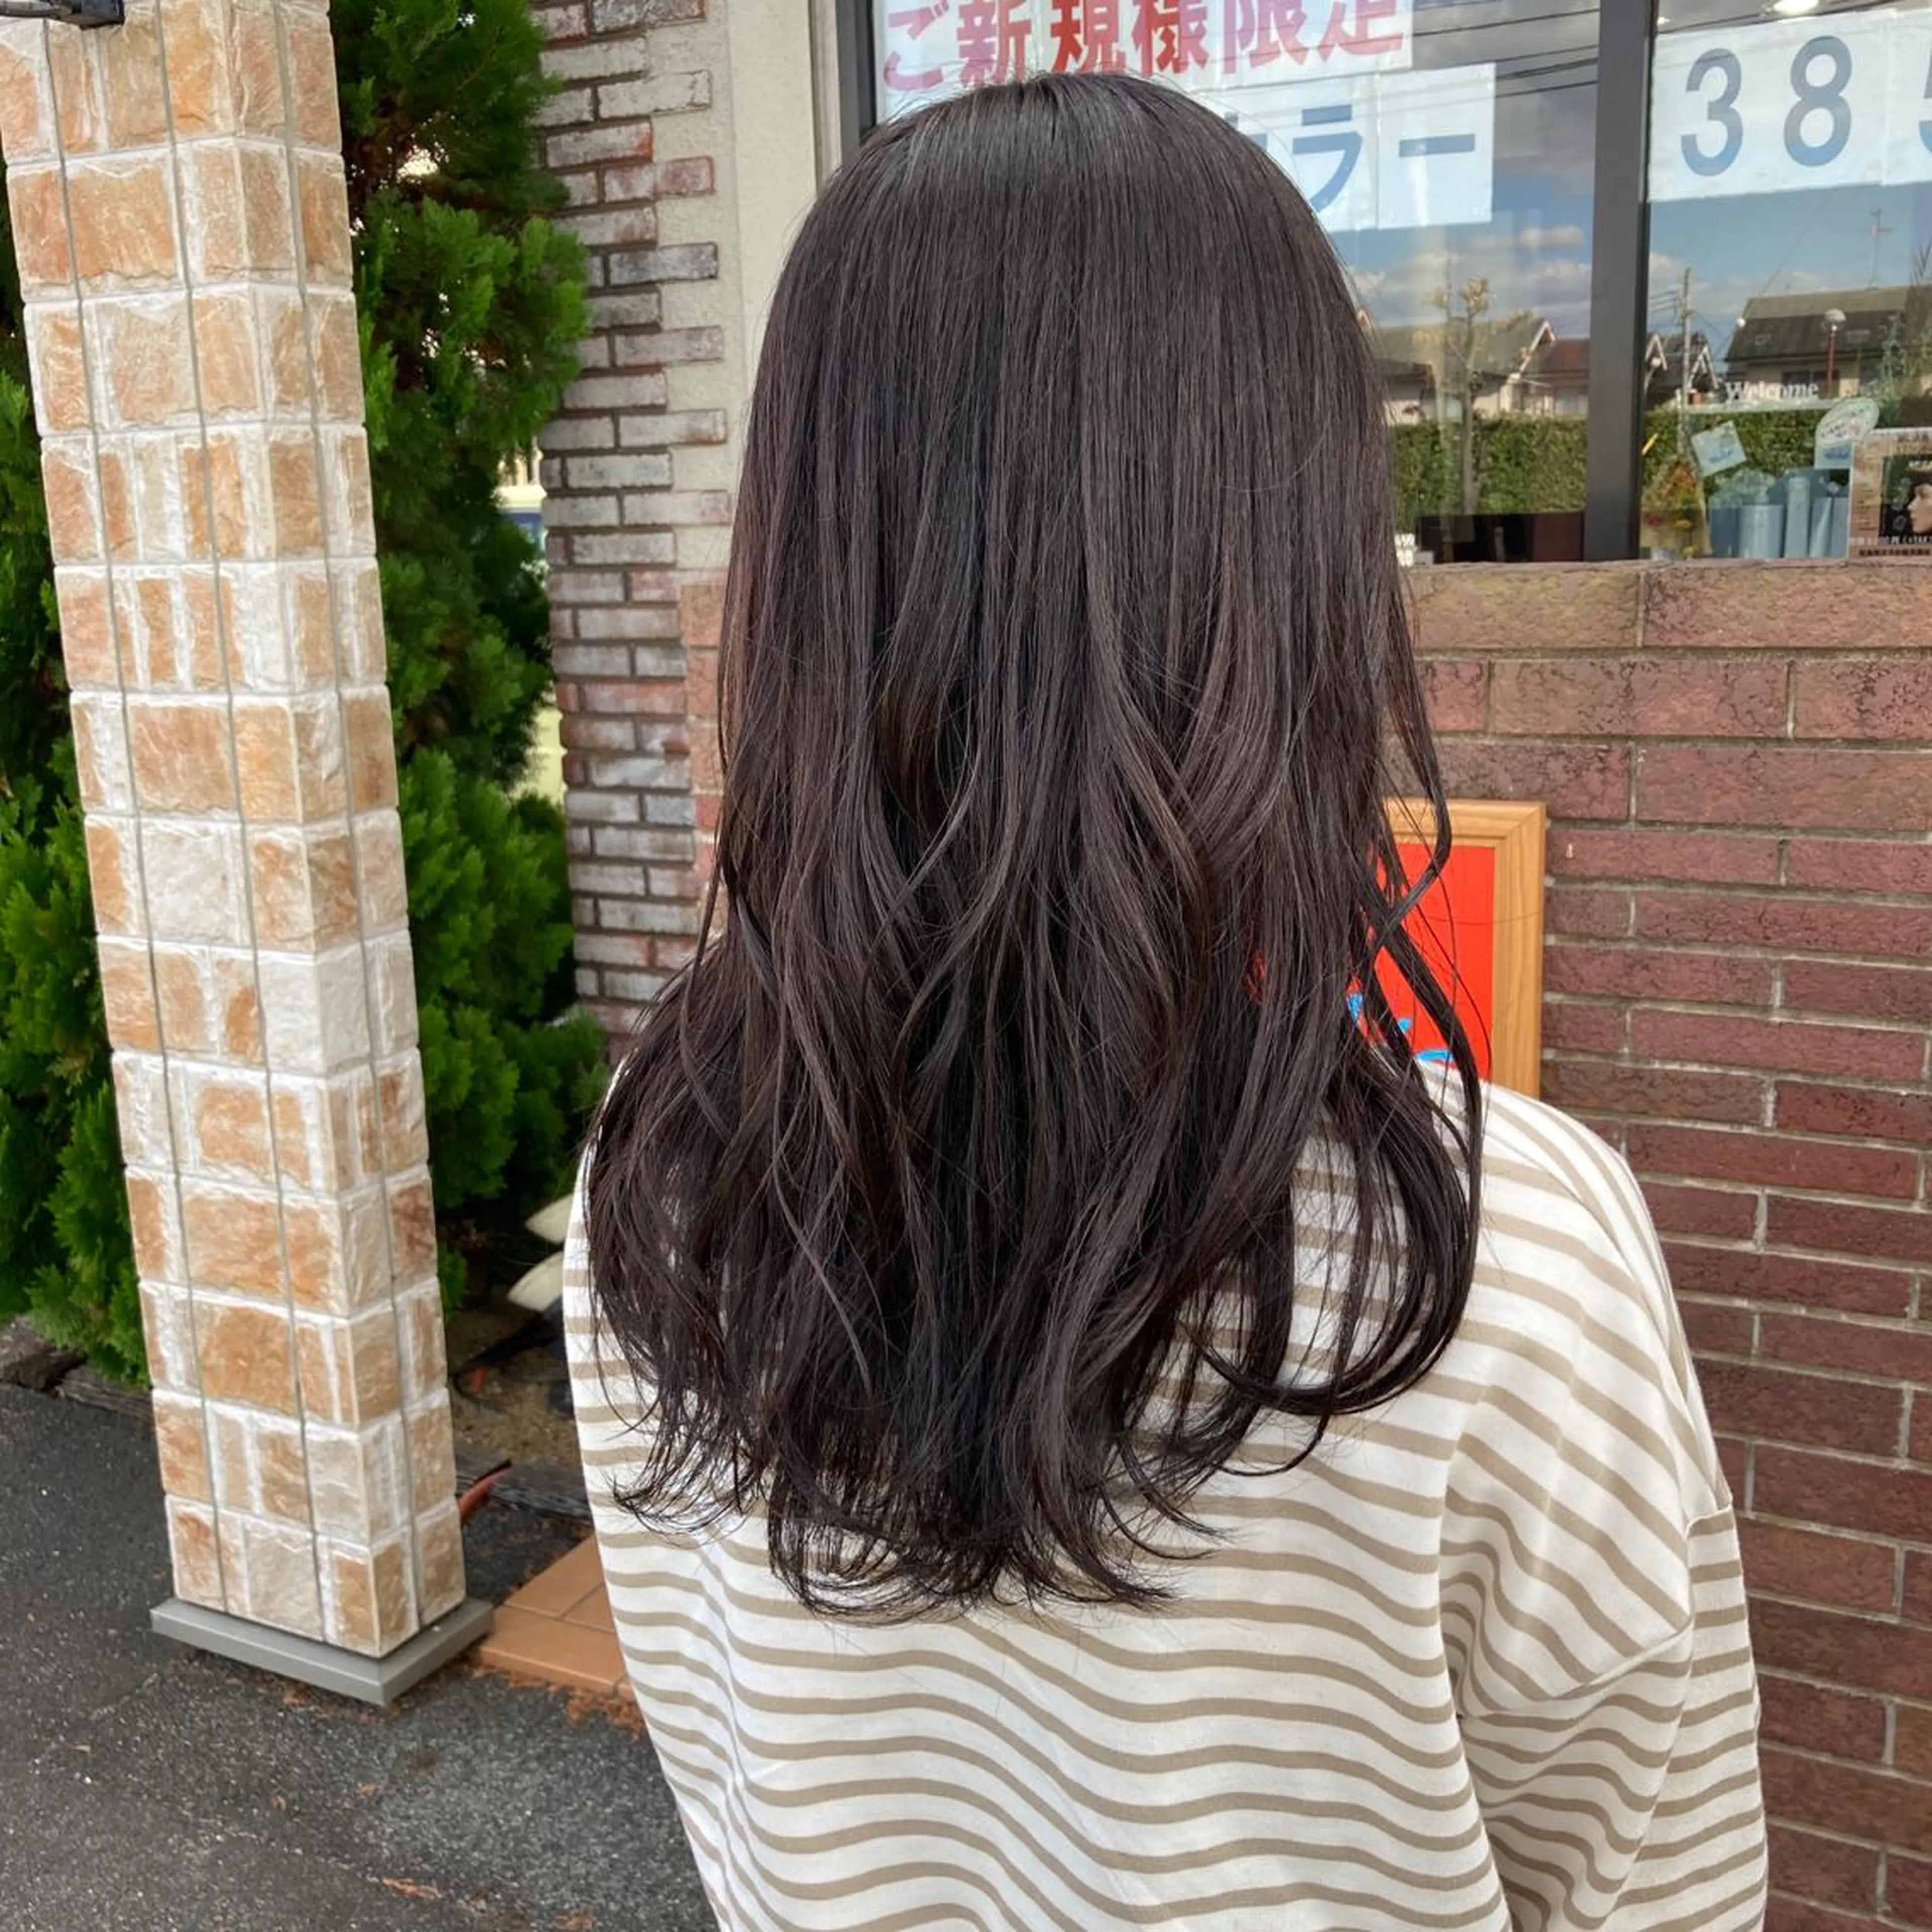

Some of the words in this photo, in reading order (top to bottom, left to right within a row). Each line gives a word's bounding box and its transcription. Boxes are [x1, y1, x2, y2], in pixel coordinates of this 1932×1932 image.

[883, 0, 1404, 90] ご新規様限定
[1680, 35, 1932, 176] 38
[1225, 104, 1476, 214] ラー
[1725, 380, 1819, 403] Welcome
